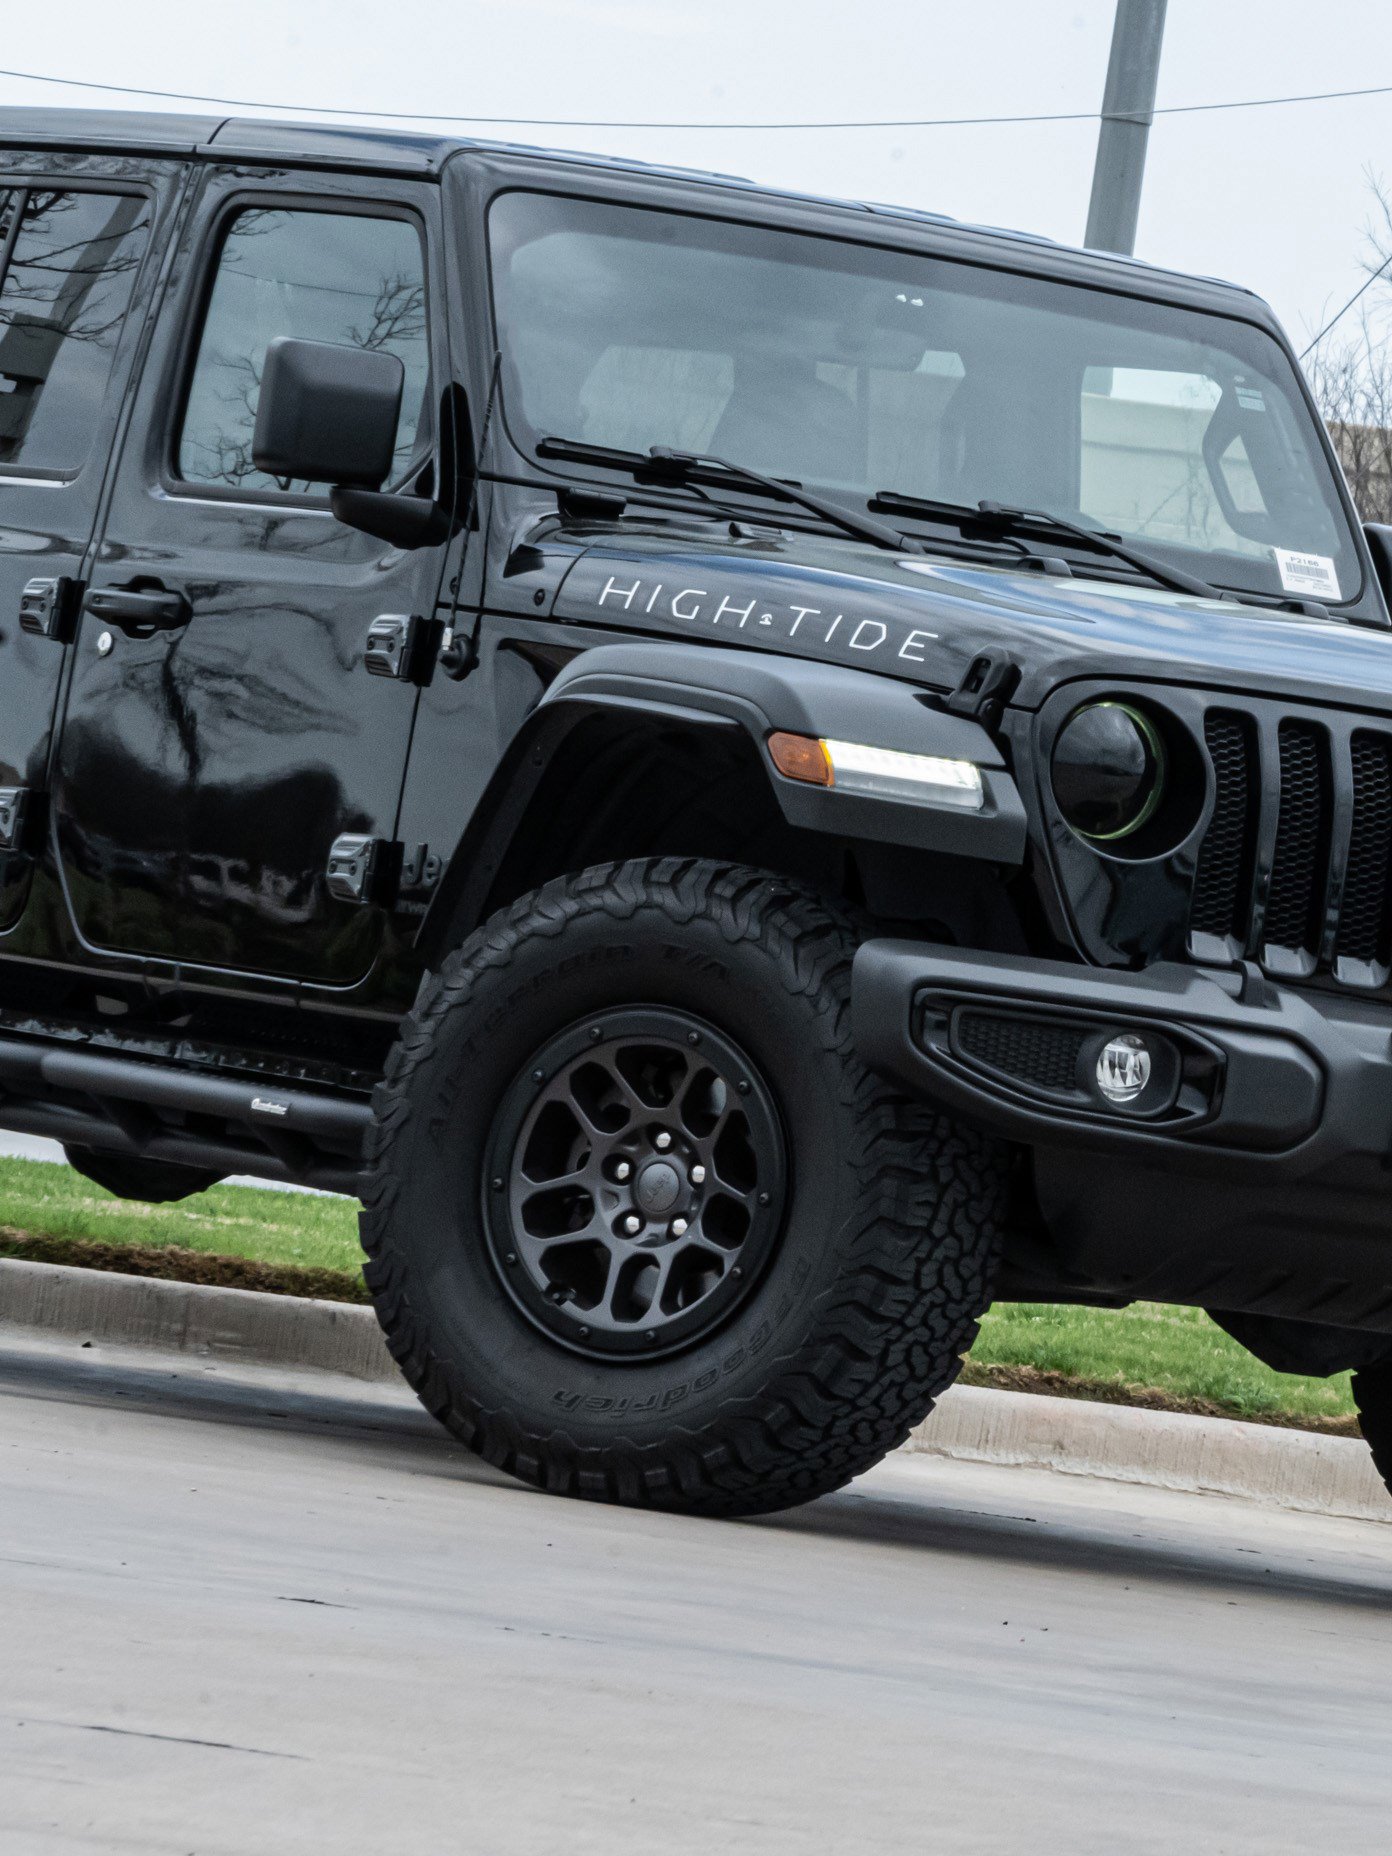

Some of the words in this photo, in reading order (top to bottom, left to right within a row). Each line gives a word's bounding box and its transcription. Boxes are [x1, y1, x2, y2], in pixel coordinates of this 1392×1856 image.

[598, 576, 757, 628] HIGH
[789, 605, 939, 662] TIDE
[400, 842, 450, 890] Je
